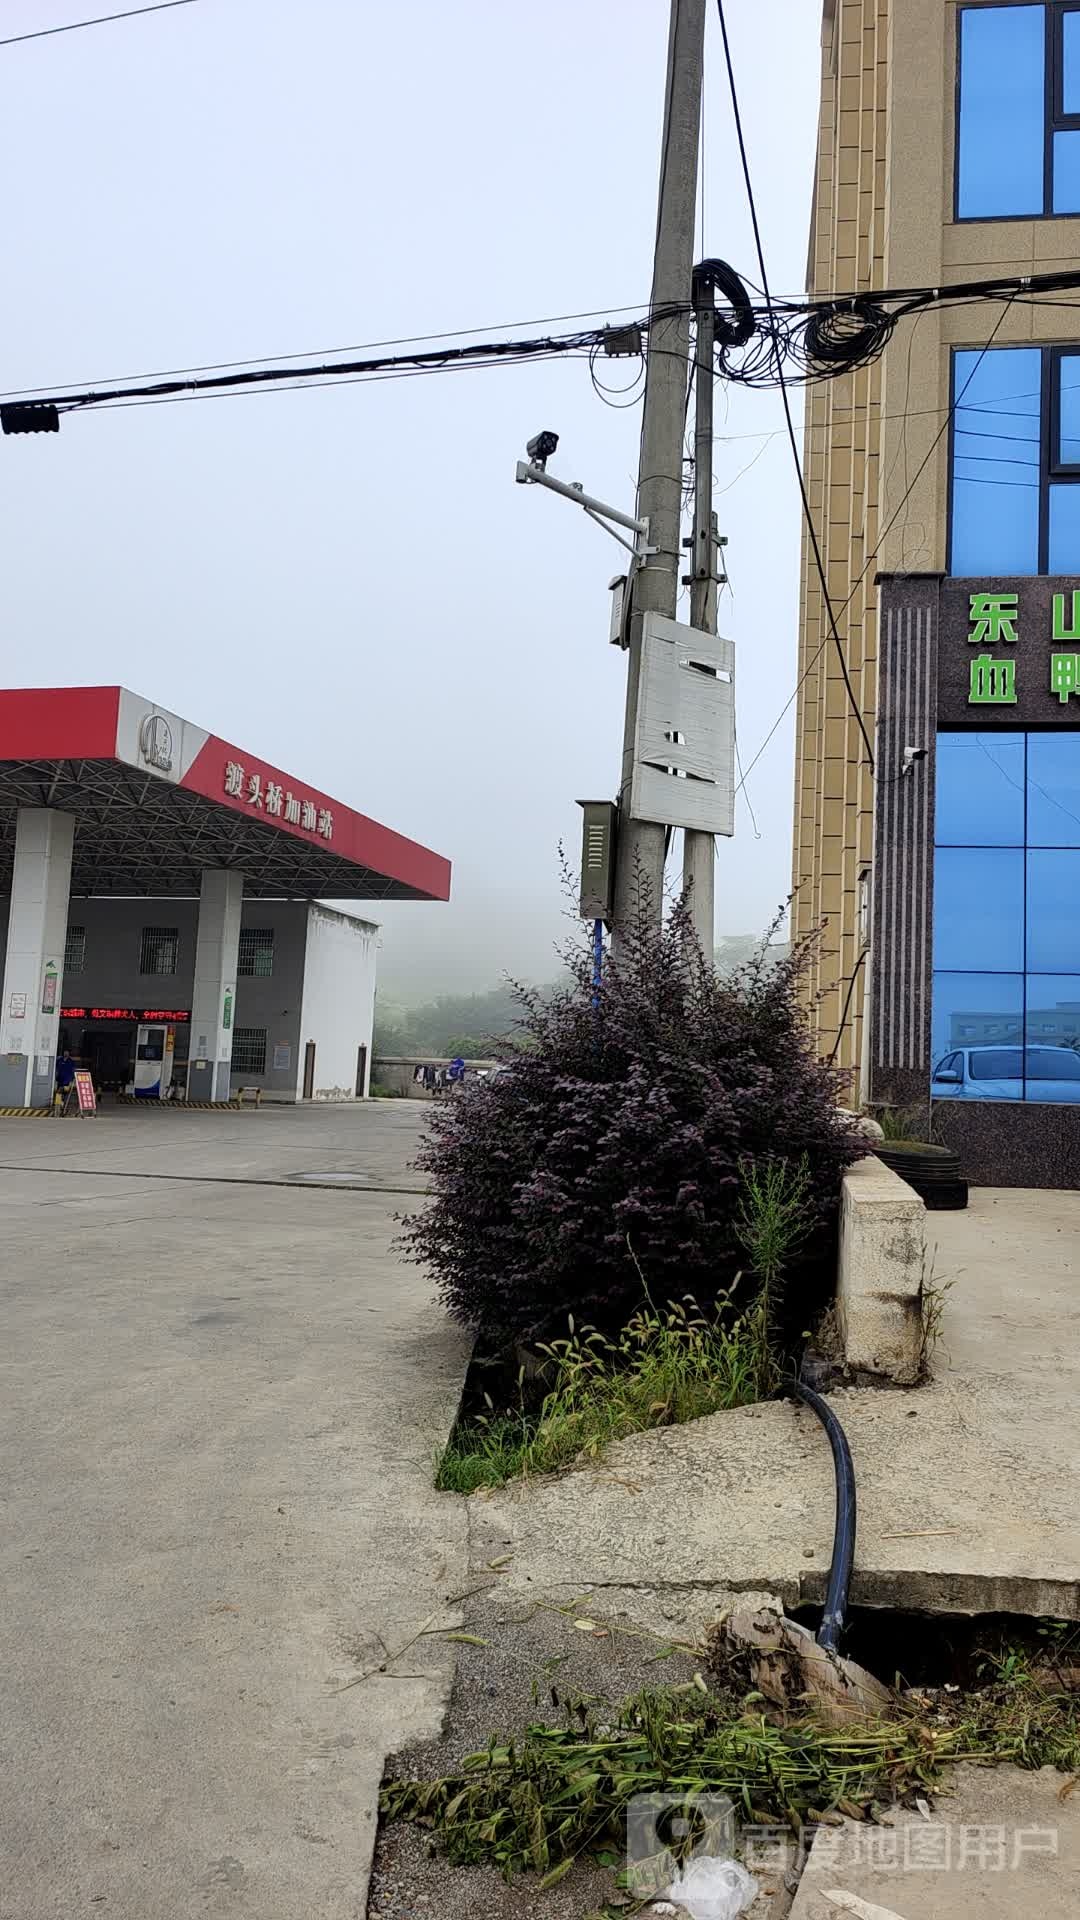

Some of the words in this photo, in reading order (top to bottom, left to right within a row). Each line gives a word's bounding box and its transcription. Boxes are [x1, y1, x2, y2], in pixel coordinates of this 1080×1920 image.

[225, 761, 333, 839] 渡头桥加油站
